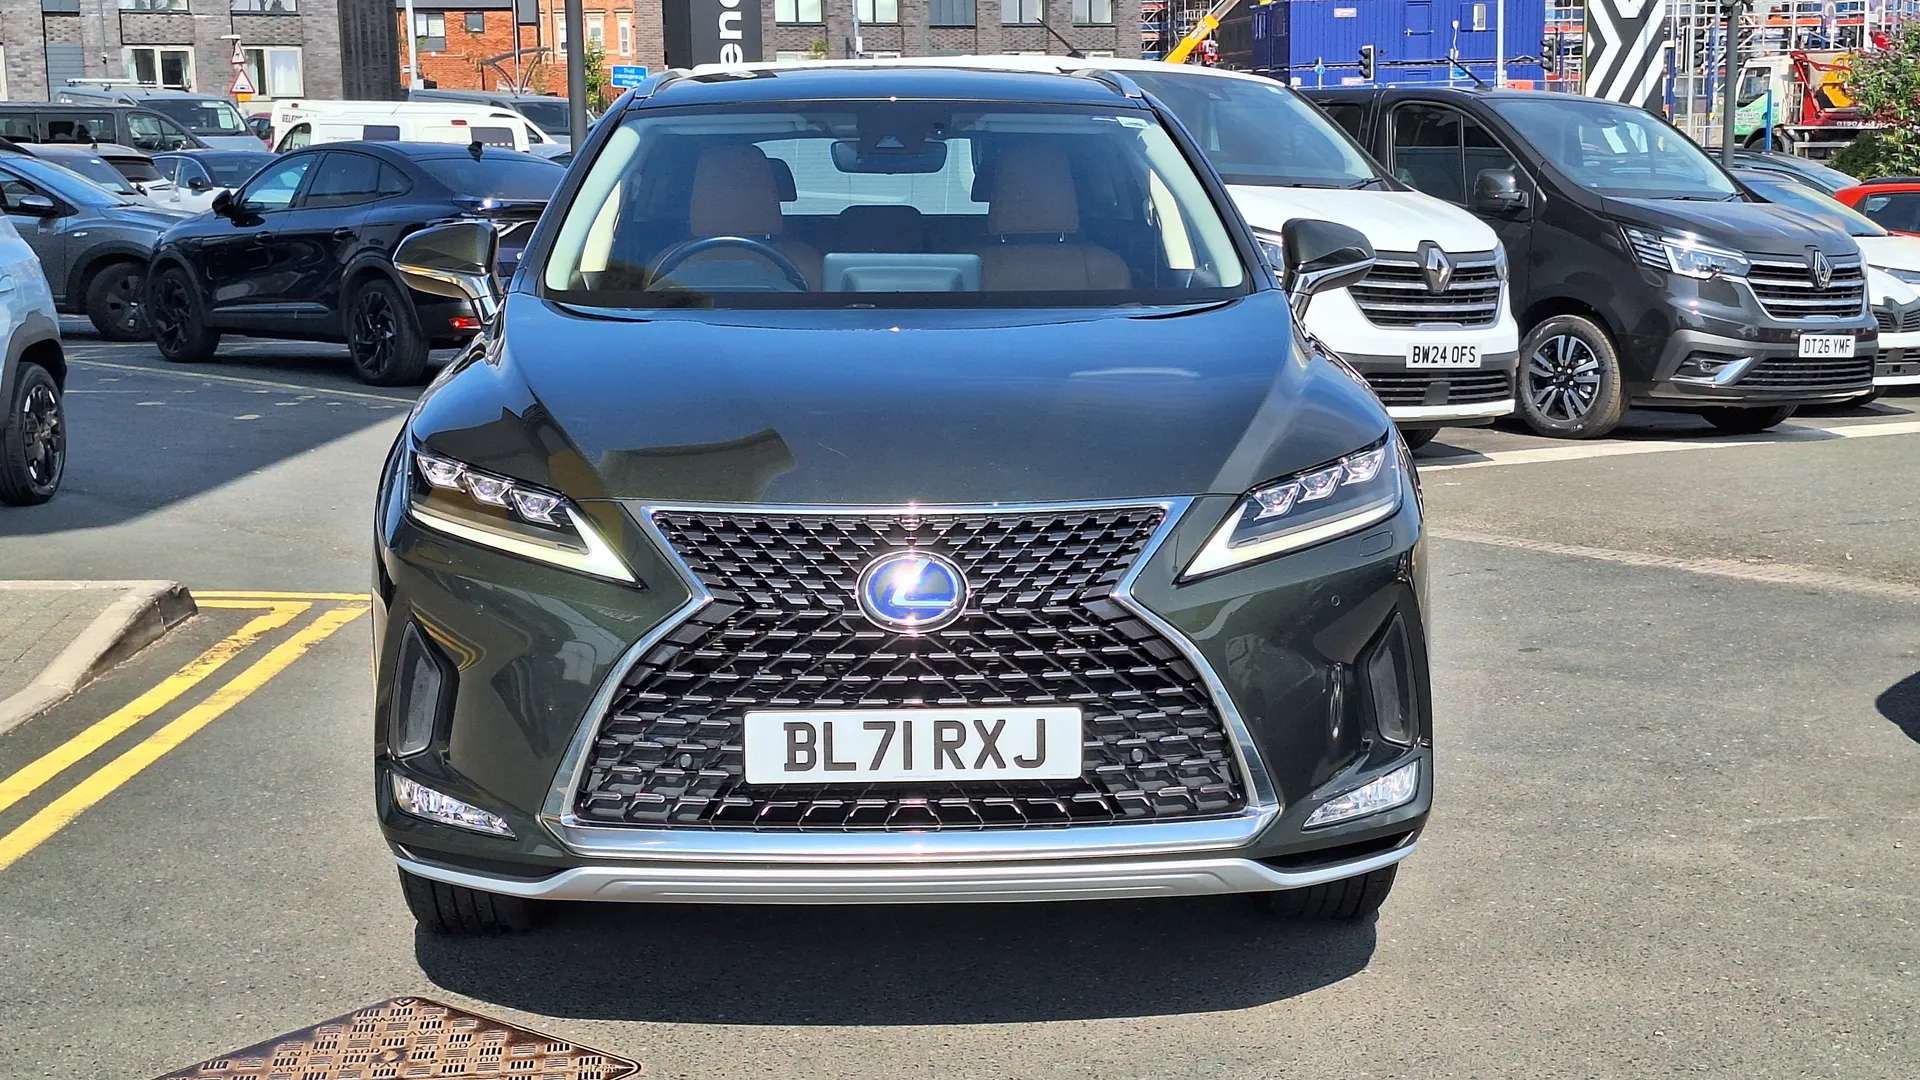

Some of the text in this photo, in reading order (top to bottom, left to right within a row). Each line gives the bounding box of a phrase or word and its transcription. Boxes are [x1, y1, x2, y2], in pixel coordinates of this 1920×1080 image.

[1412, 345, 1476, 364] BW24 OFS
[1804, 338, 1851, 353] DT26 YMF
[783, 718, 1046, 772] BL71 RXJ
